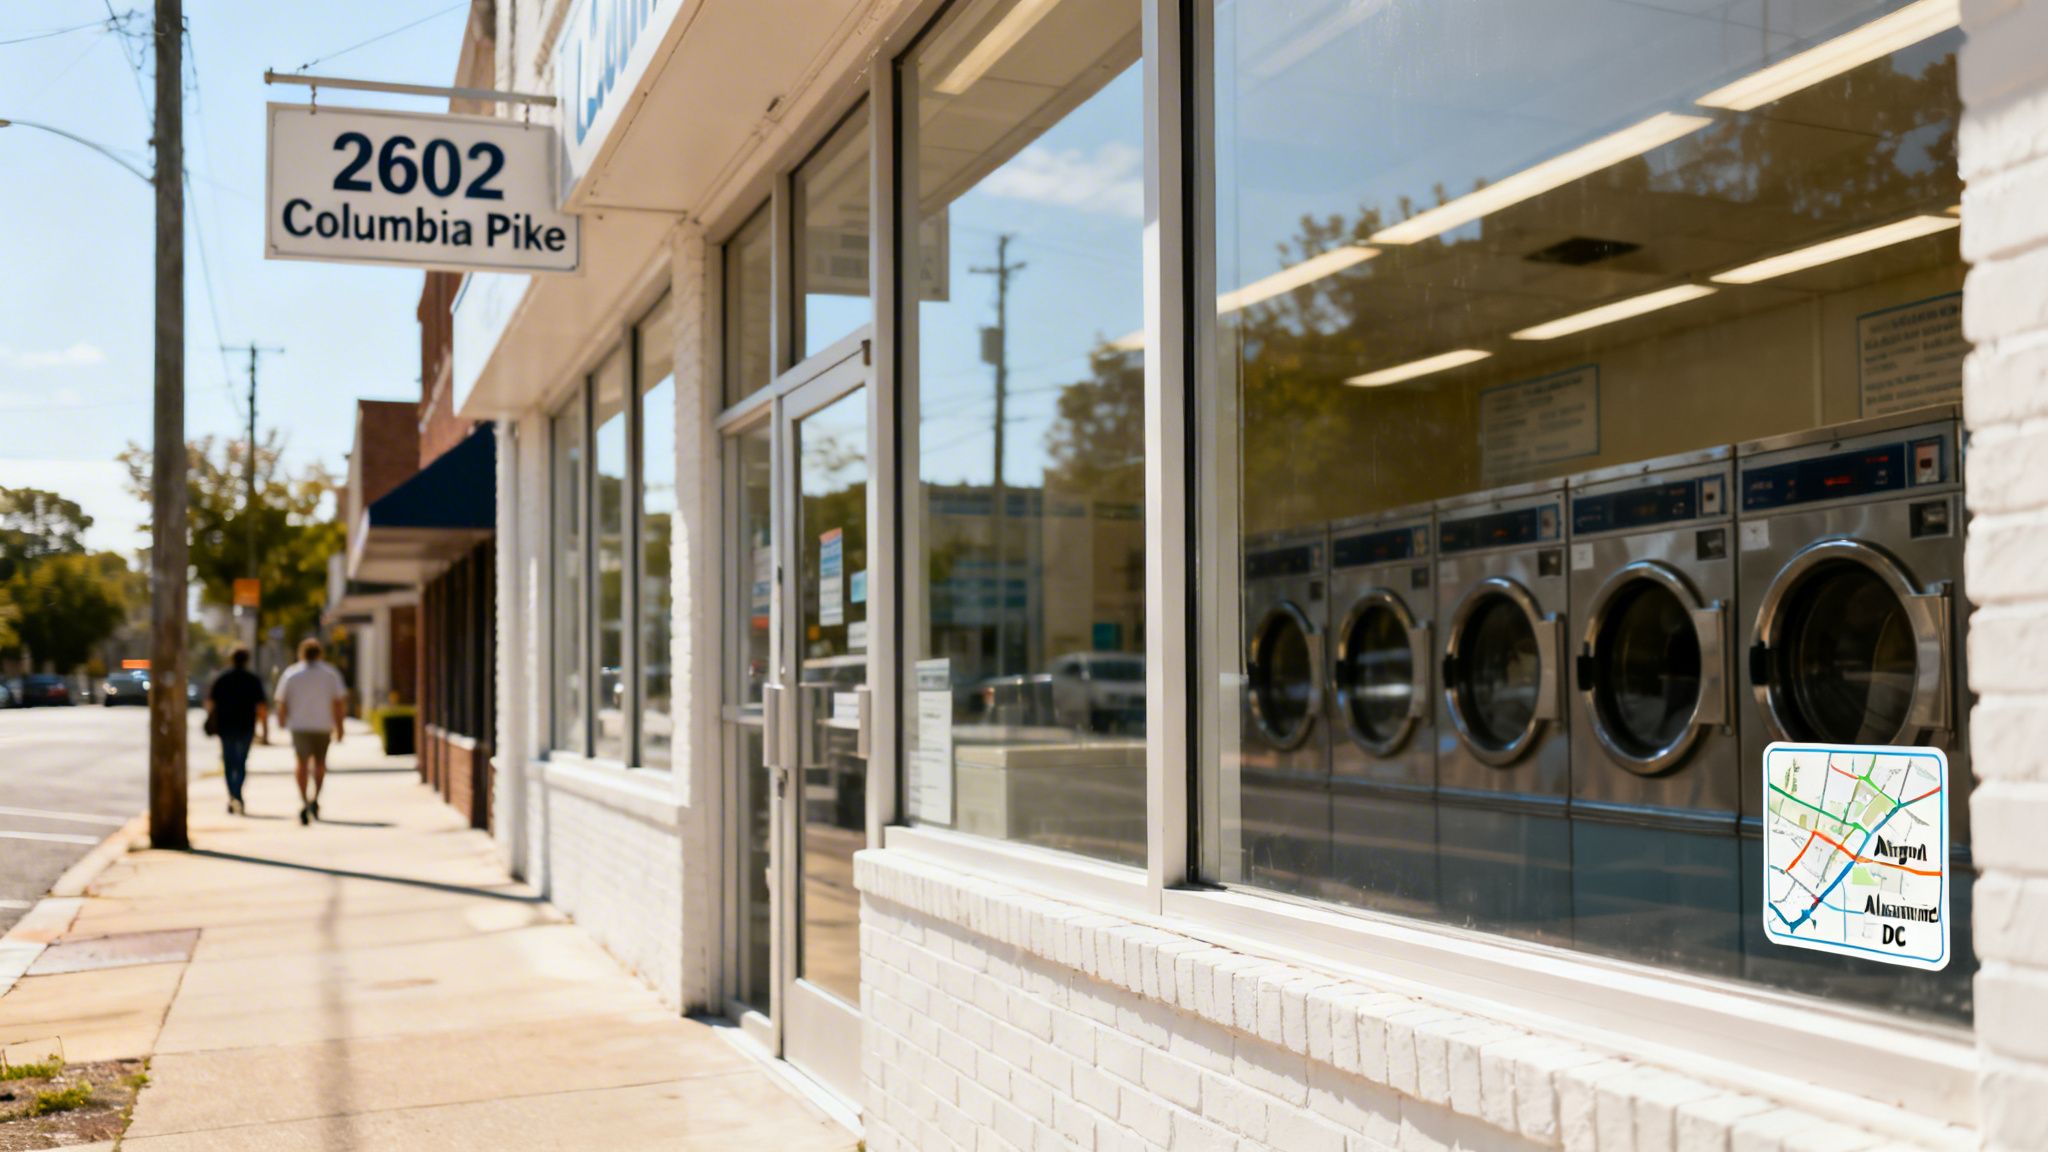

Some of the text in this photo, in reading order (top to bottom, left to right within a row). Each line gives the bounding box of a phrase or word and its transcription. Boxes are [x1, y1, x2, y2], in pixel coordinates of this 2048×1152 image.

[332, 131, 506, 201] 2602
[282, 198, 567, 252] Columbia Pike
[1882, 923, 1906, 947] DC
